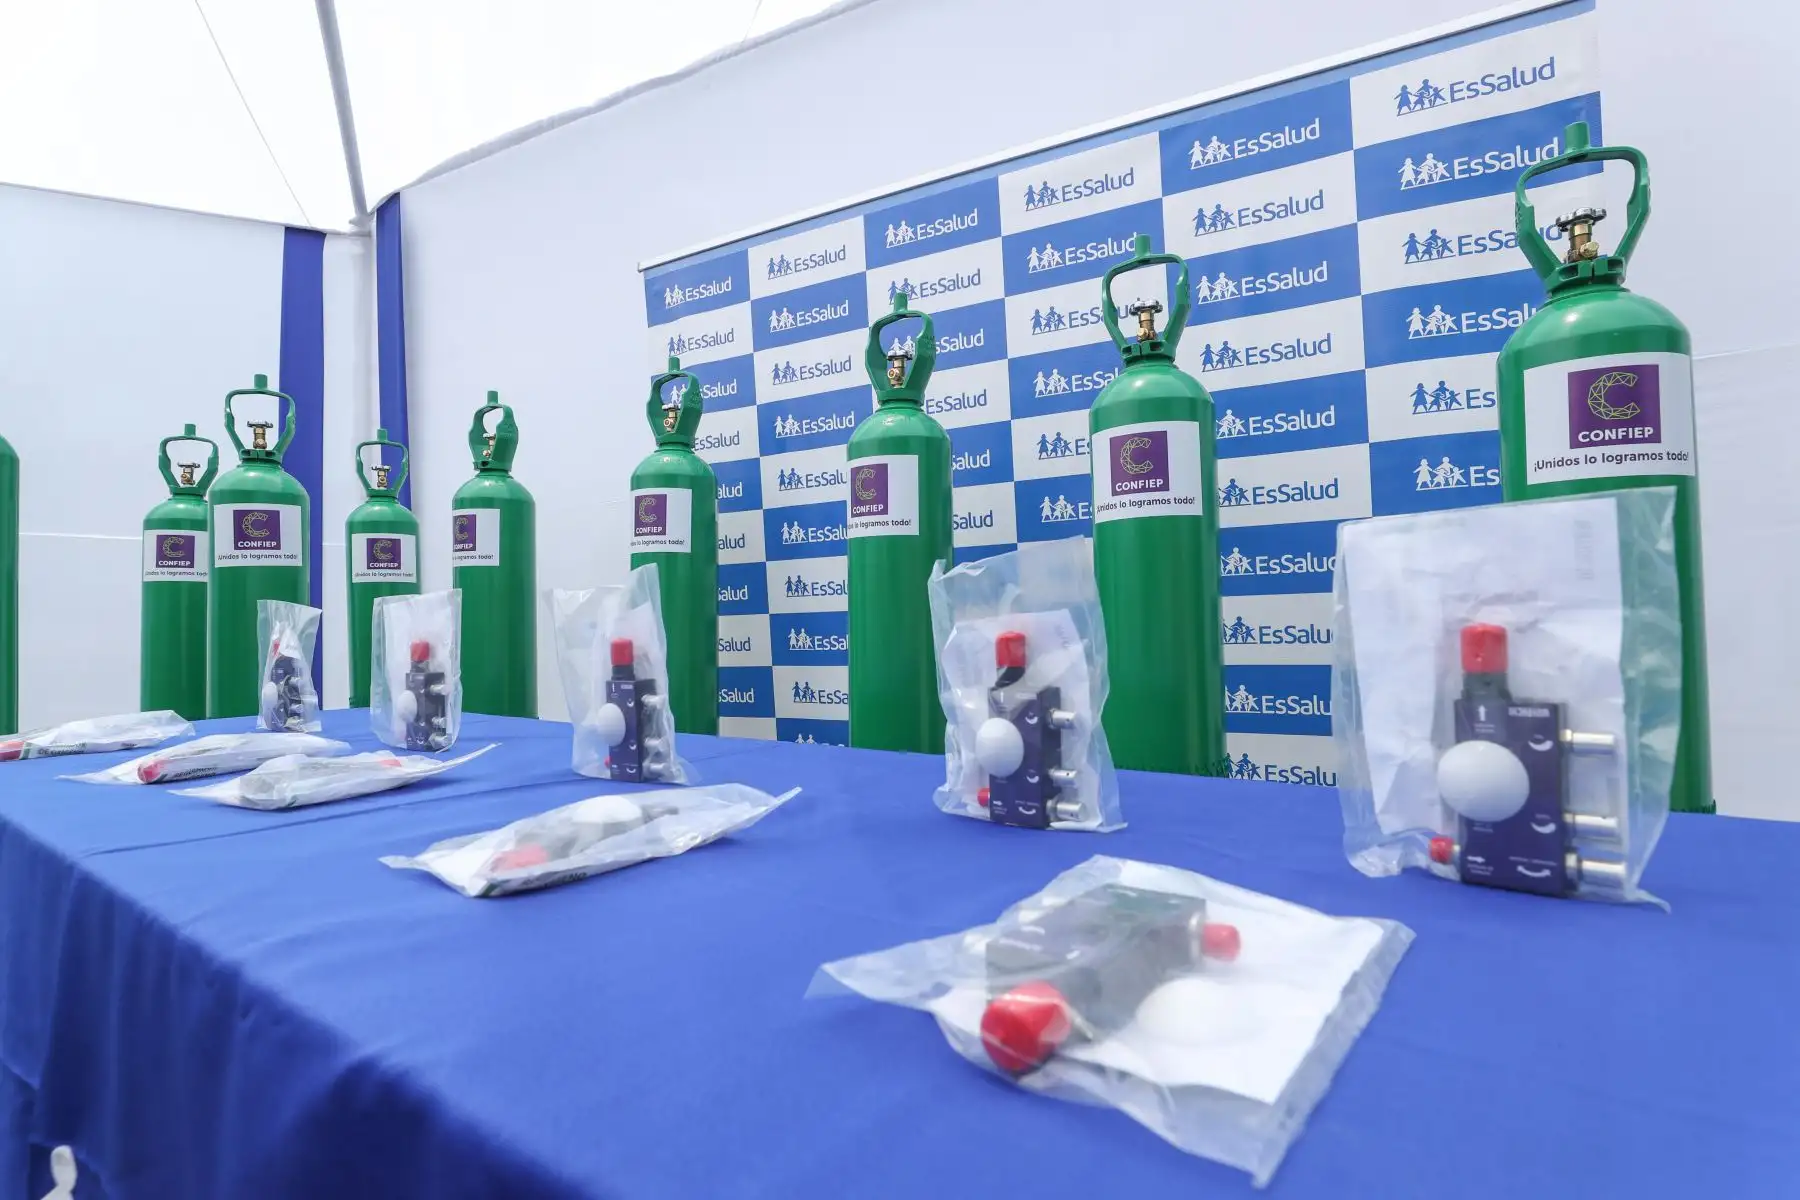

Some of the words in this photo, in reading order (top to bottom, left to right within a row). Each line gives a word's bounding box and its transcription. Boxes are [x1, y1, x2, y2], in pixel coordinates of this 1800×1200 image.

[1449, 56, 1556, 103] EsSalud
[1234, 117, 1320, 159] EsSalud
[1453, 137, 1559, 180] EsSalud
[1062, 167, 1136, 203] EsSalud
[1238, 189, 1324, 228] EsSalud
[917, 208, 979, 241] EsSalud
[793, 244, 847, 273] EsSalud
[1065, 231, 1137, 266] EsSalud
[685, 276, 732, 302] EsSalud
[920, 268, 981, 298] EsSalud
[1241, 260, 1328, 297] EsSalud
[797, 300, 849, 326] EsSalud
[1462, 302, 1537, 334] EsSal
[687, 327, 735, 352] EsSalud
[935, 329, 985, 355] sSalud
[1245, 332, 1332, 366] EsSalud
[800, 355, 852, 381] EsSalud
[1072, 367, 1119, 392] EsSal
[701, 378, 738, 399] Salud
[925, 389, 988, 415] EsSalud
[802, 411, 855, 435] EsSalud
[1249, 405, 1336, 436] EsSalud
[694, 430, 741, 451] EsSalud
[1578, 426, 1654, 444] CONFIEP
[952, 448, 991, 471] alud
[1533, 456, 1580, 472] ¡Unidos
[1584, 453, 1598, 464] lo
[1601, 450, 1664, 466] logramos
[717, 481, 743, 499] alud
[805, 469, 847, 489] EsSalu
[1115, 479, 1164, 492] CONFIEP
[1129, 497, 1171, 508] logramos
[1173, 496, 1195, 505] todo!
[1252, 477, 1339, 506] EsSalud
[852, 504, 884, 514] CONFIEP
[952, 510, 994, 530] Salud
[635, 526, 663, 534] CONFIEP
[808, 522, 848, 543] EsSal
[859, 520, 890, 529] logramos
[718, 533, 746, 550] alud
[1256, 552, 1336, 575] EsSalu
[718, 584, 748, 601] alud
[811, 580, 848, 597] EsSal
[718, 636, 751, 652] Salud
[814, 635, 848, 651] EsSal
[1259, 623, 1333, 645] EsSalu
[718, 687, 755, 703] Salud
[818, 690, 848, 705] EsSa
[1262, 695, 1332, 716] EsSalu
[1265, 764, 1338, 787] EsSalu
